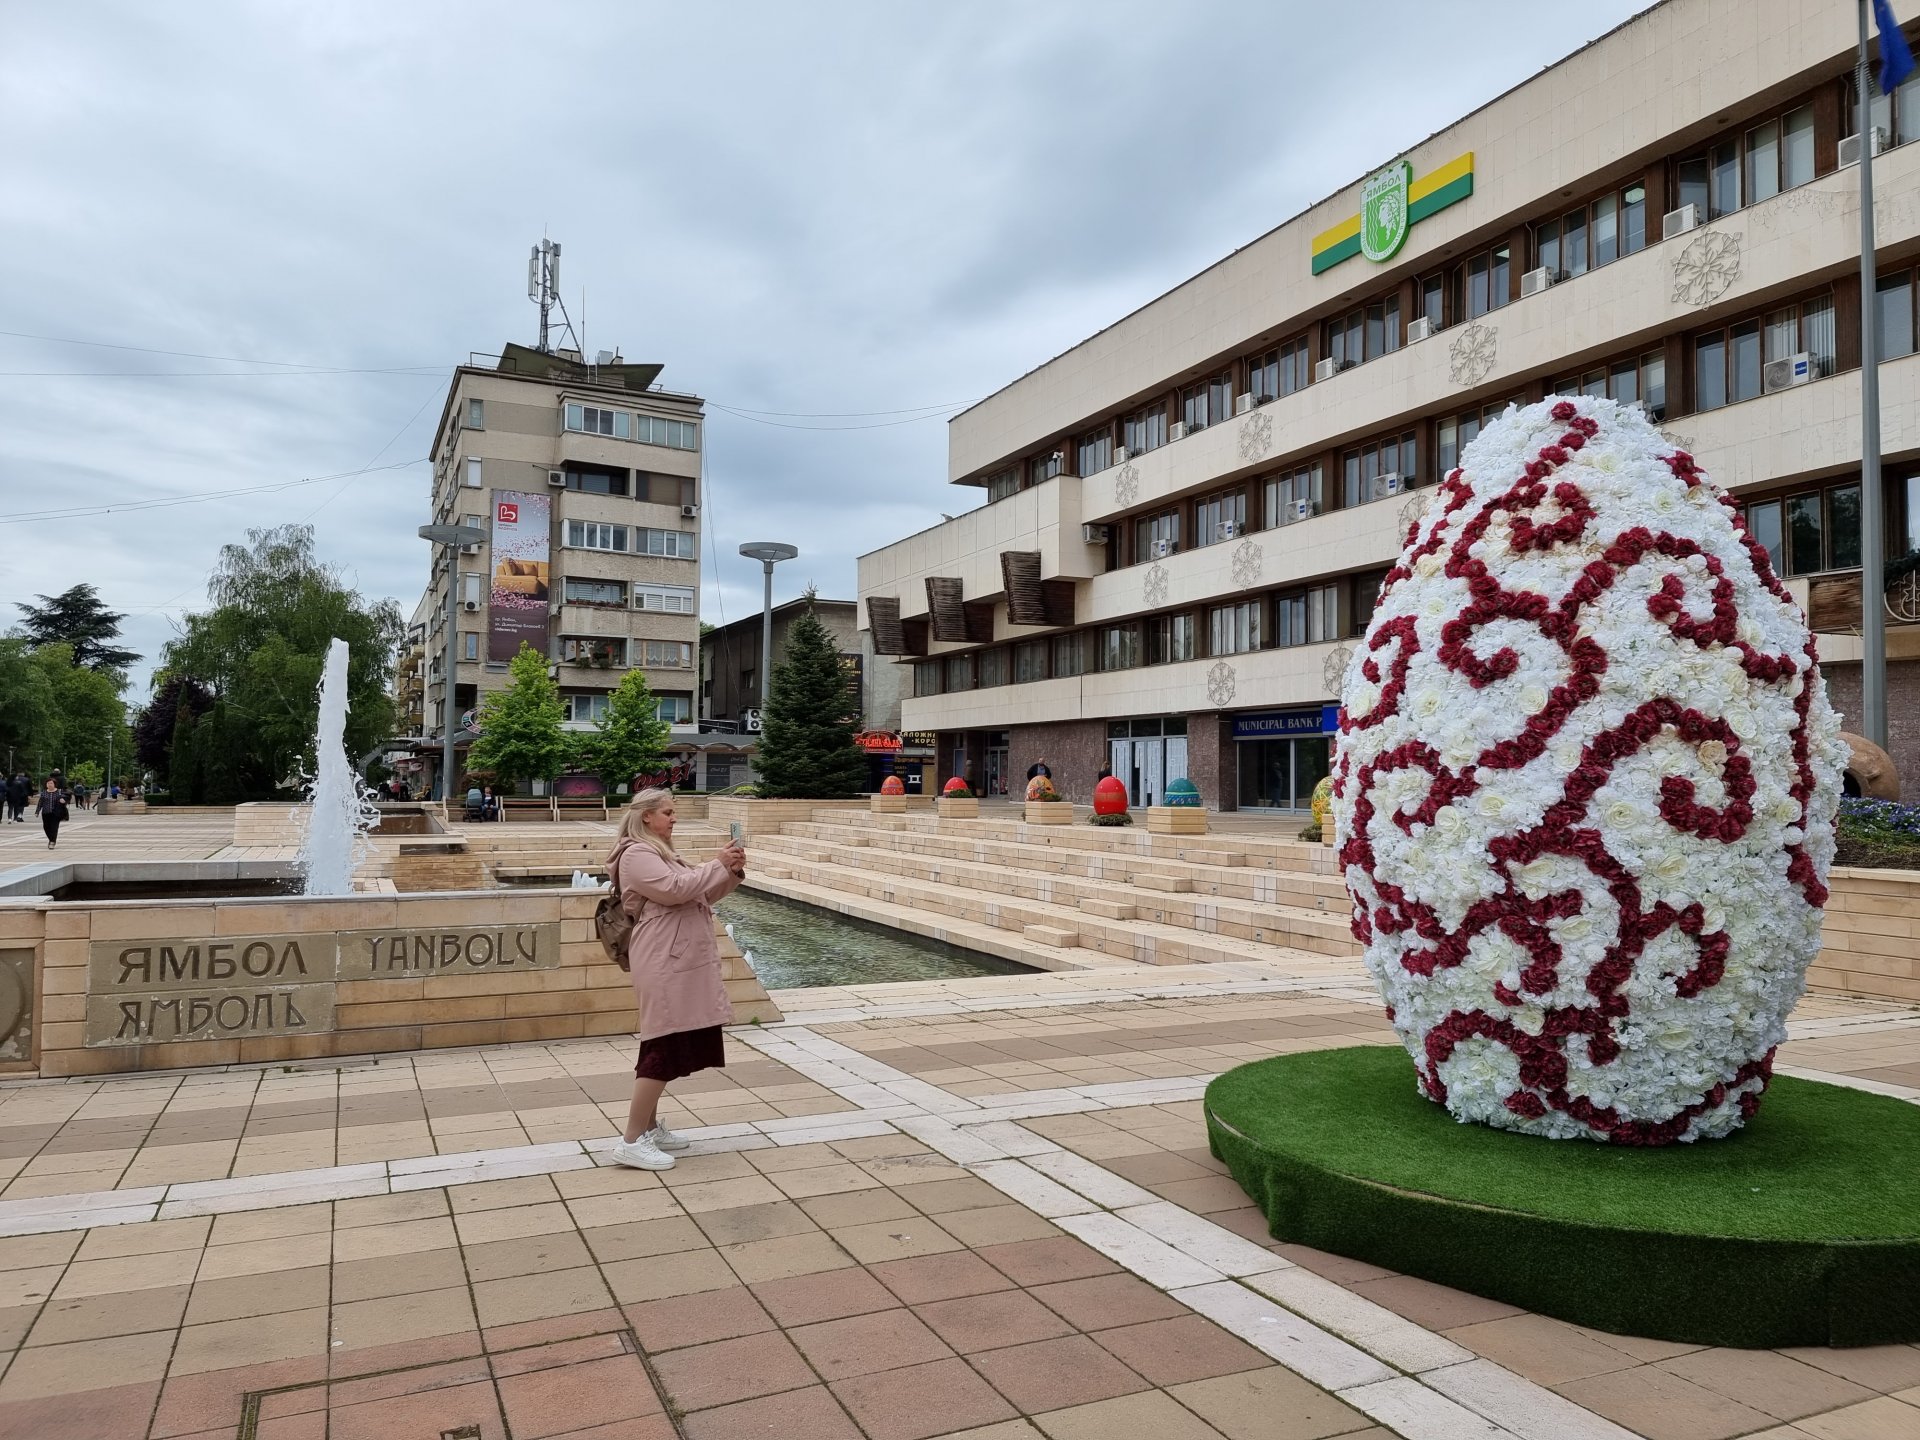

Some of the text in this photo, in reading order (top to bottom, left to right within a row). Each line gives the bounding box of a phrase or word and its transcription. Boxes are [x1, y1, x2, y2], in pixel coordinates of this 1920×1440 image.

[1366, 174, 1401, 200] ЯМБОЛ
[1238, 719, 1285, 731] MUNICIPAL
[1287, 717, 1313, 729] BANK
[117, 941, 308, 985] ЯМБОЛ
